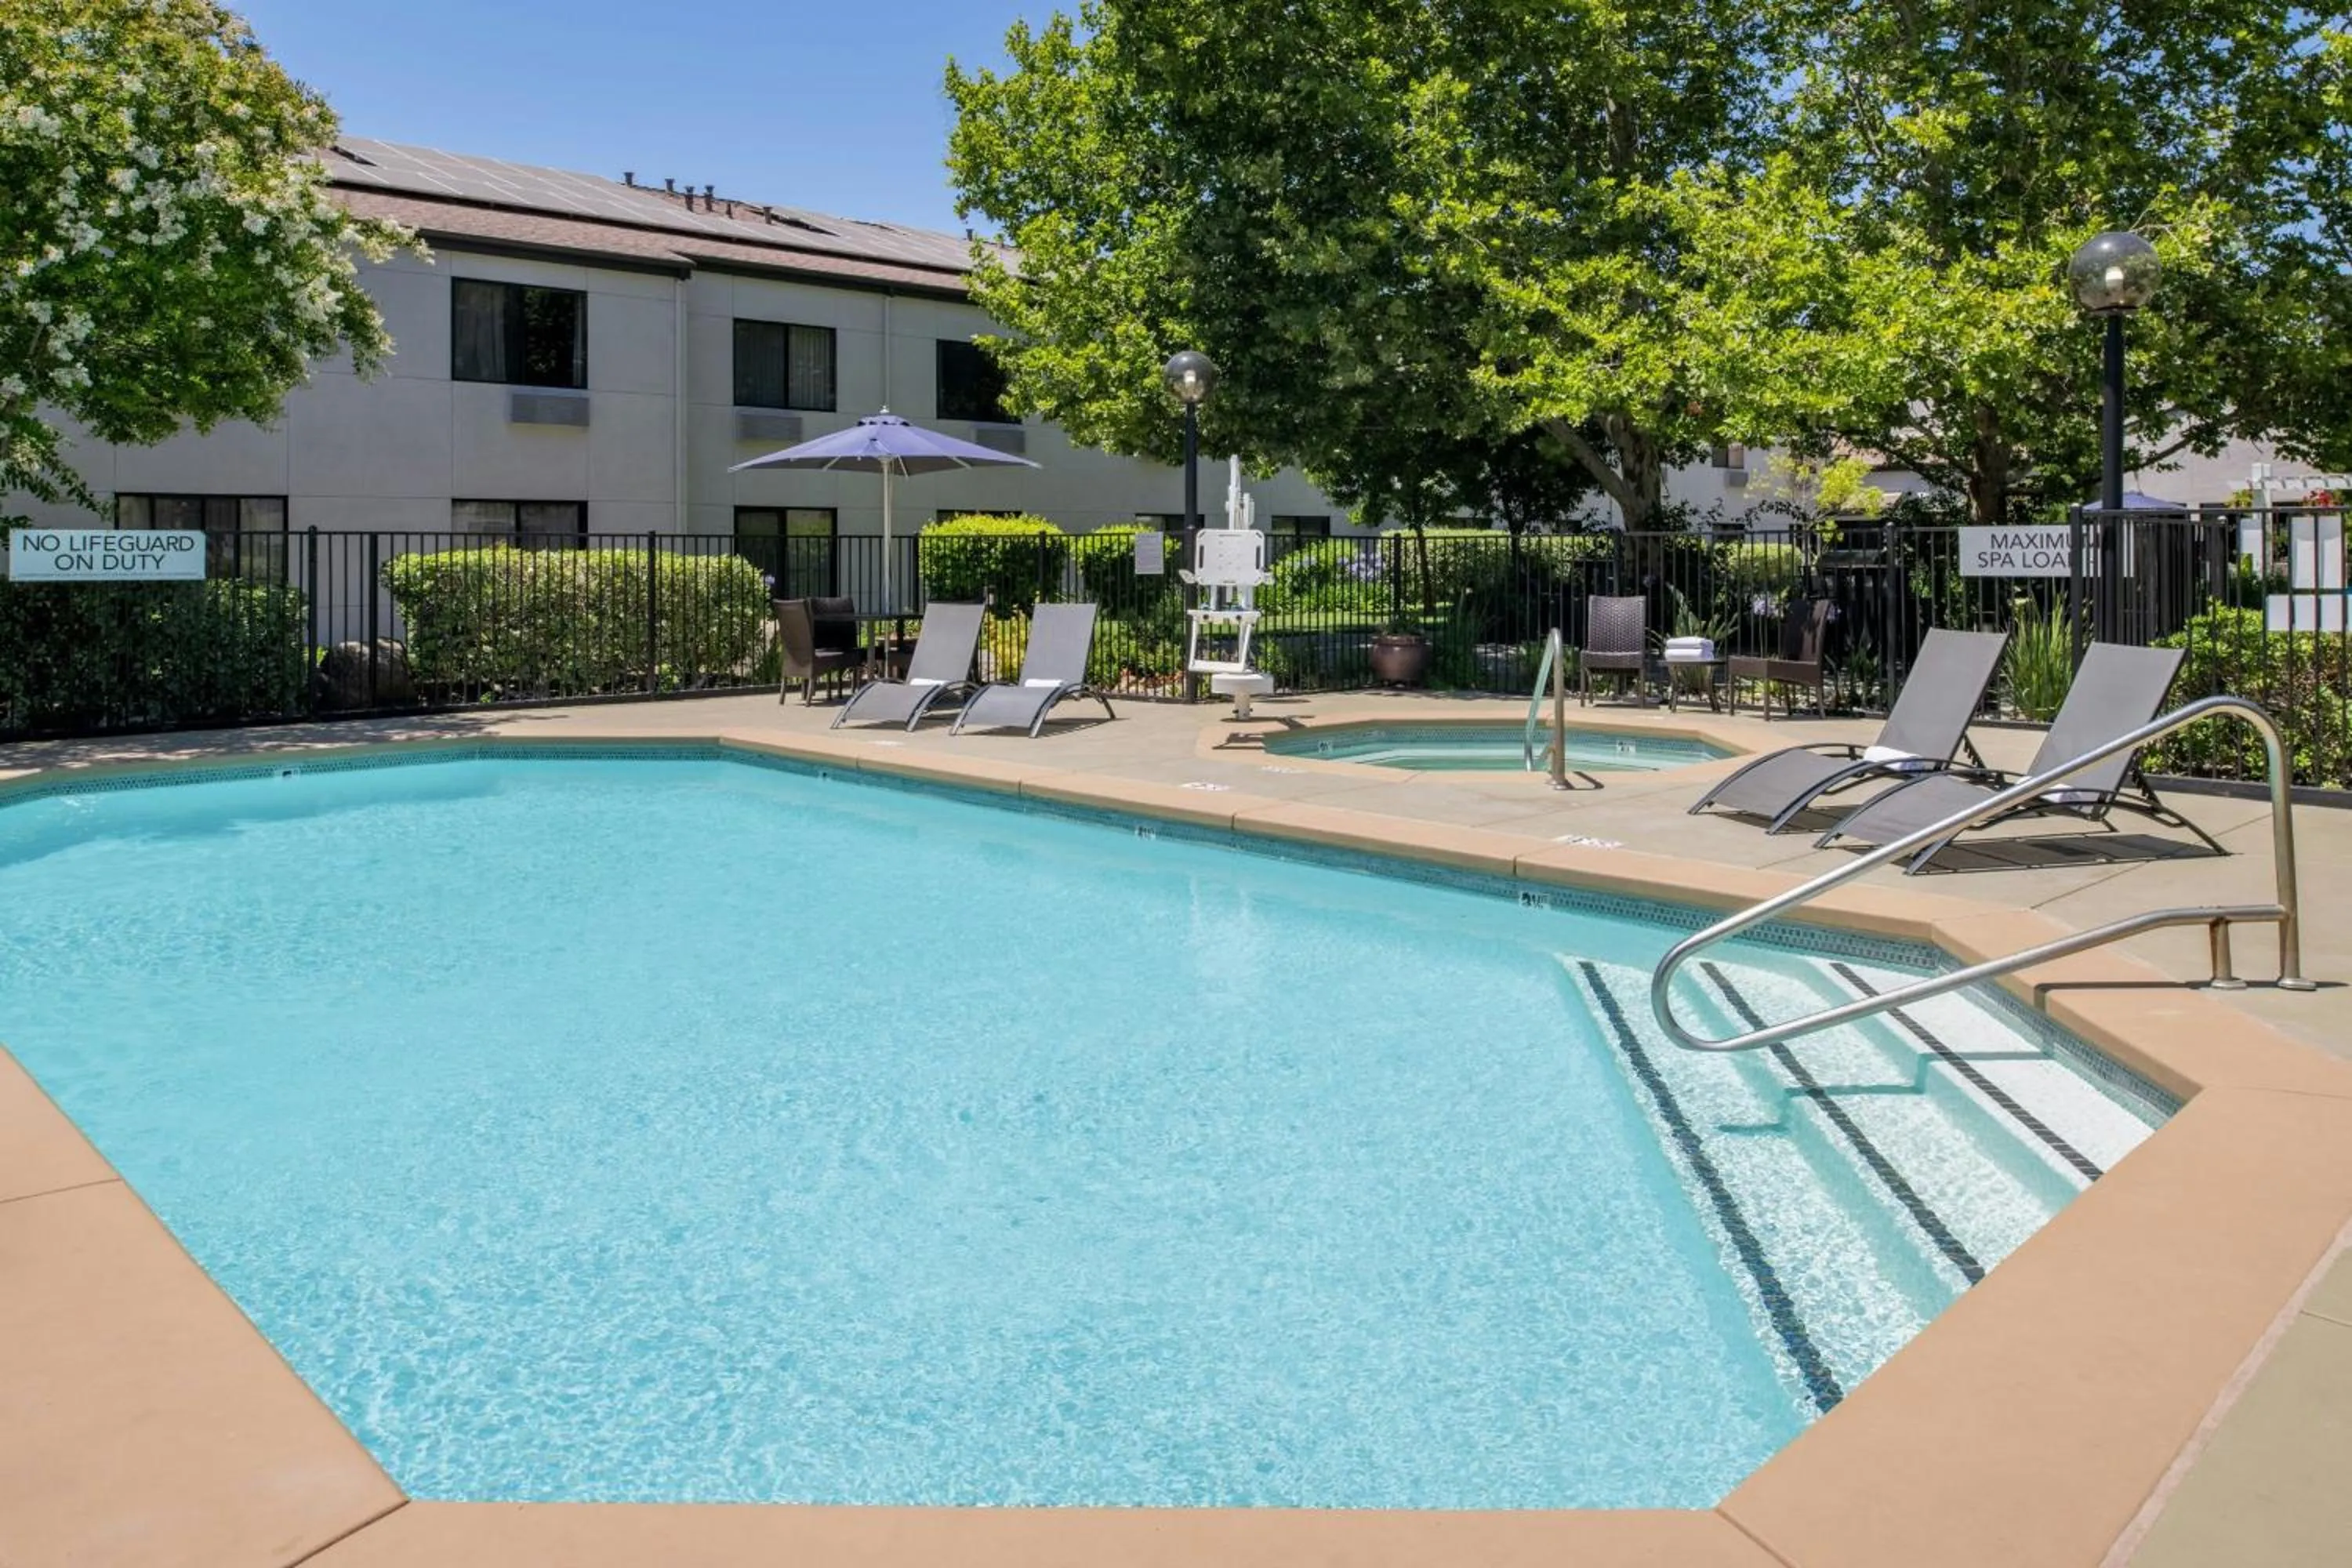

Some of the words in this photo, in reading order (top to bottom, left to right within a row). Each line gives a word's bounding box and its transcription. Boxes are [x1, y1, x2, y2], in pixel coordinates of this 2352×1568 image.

[23, 535, 60, 551] NO
[70, 535, 195, 552] LIFEGUARD
[54, 554, 93, 571] ON
[103, 554, 165, 571] DUTY
[1978, 551, 2015, 568] SPA
[2022, 551, 2072, 568] LOA
